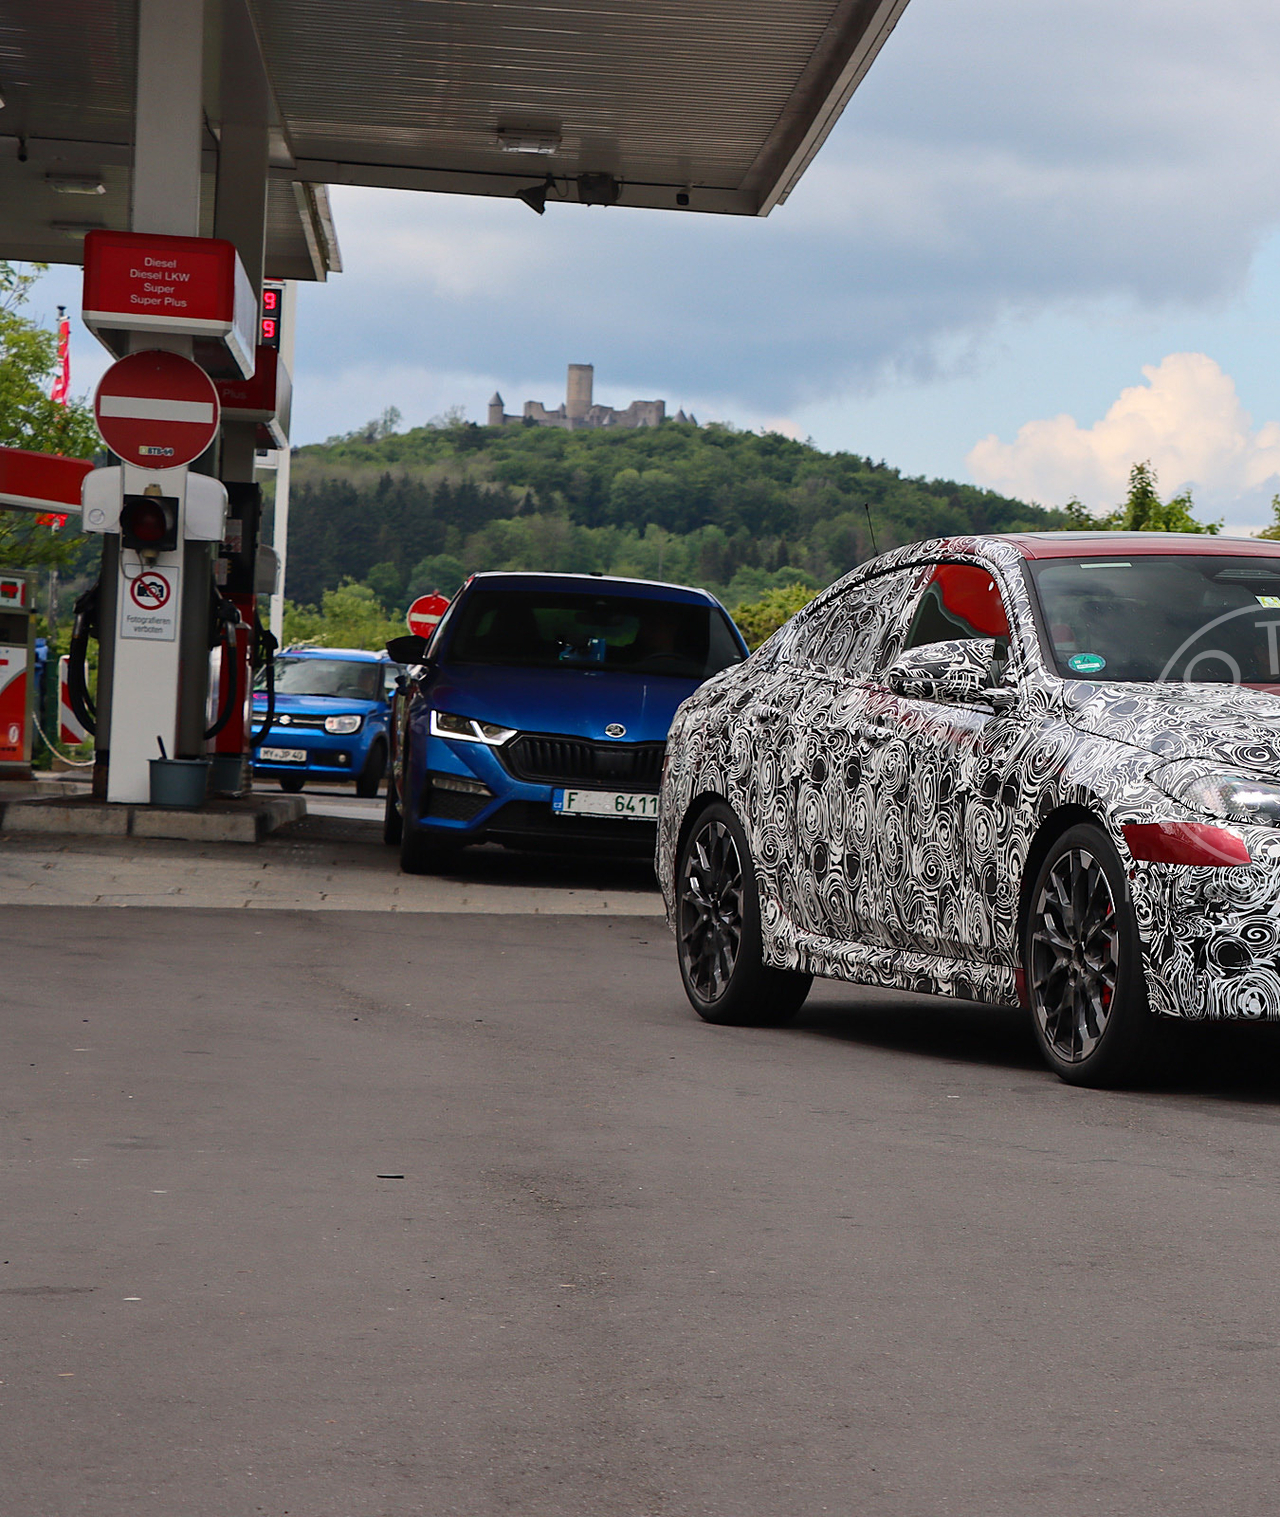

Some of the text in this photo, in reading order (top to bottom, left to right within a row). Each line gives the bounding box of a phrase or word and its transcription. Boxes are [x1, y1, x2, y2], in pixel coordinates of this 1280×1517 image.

[144, 257, 177, 268] Diesel
[130, 269, 190, 281] Diesel LKW
[144, 283, 175, 294] Super
[130, 294, 187, 307] Super Plus
[263, 292, 276, 310] 9
[262, 320, 275, 338] 9
[126, 614, 172, 626] Fotografieren
[133, 625, 164, 634] verboten
[568, 792, 578, 809] F
[615, 795, 658, 814] 6411
